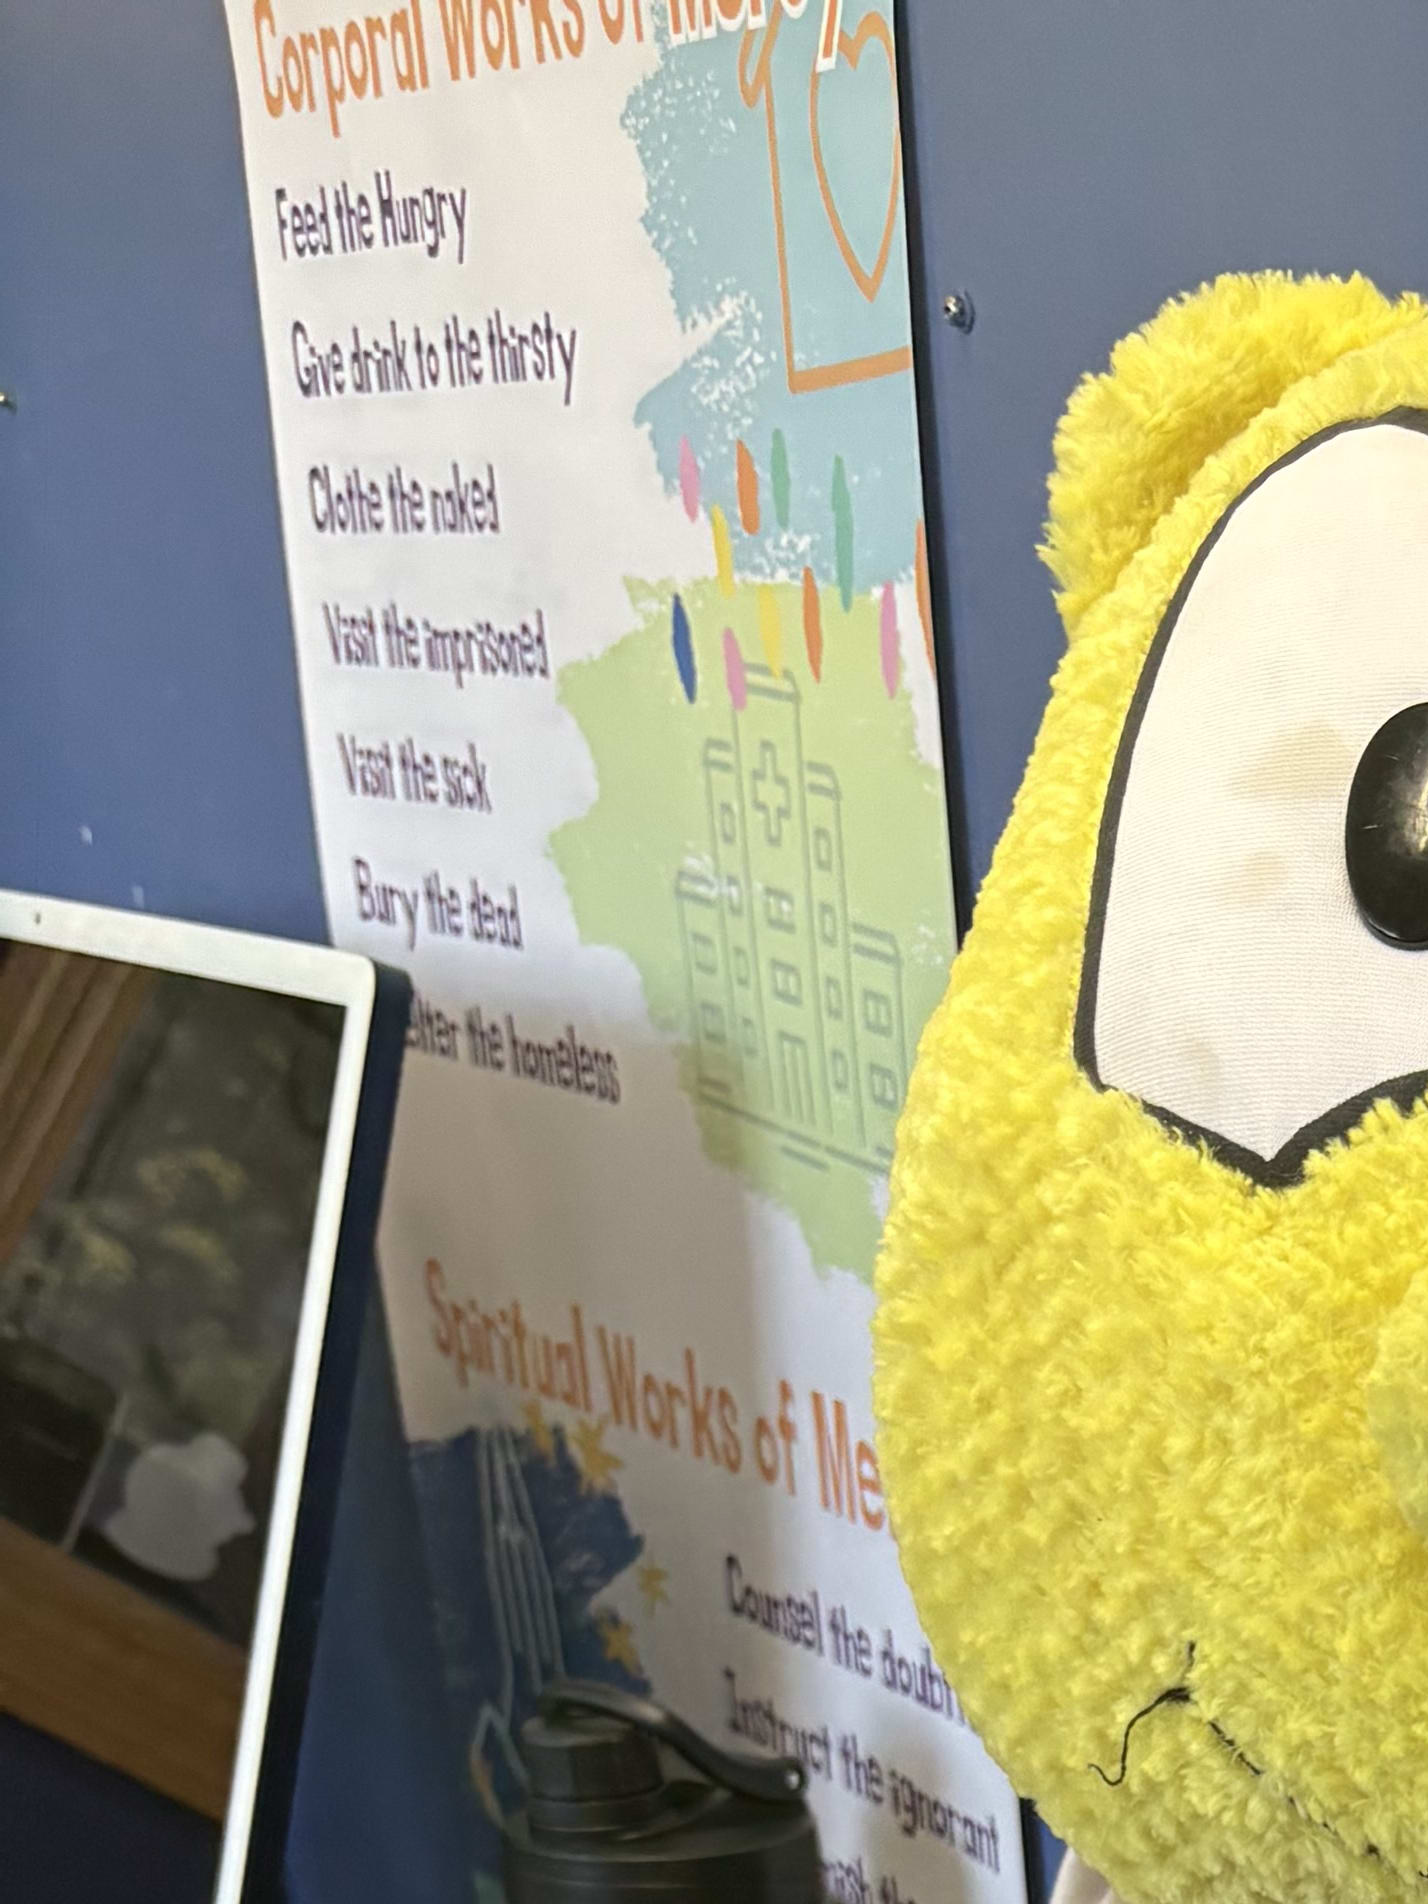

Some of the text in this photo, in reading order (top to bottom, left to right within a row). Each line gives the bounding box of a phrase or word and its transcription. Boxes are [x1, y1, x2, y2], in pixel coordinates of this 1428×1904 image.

[275, 169, 467, 264] Feed the Hungry
[291, 307, 577, 407] Give drink to the thirsty
[308, 461, 501, 534] Clothe the naked
[321, 600, 550, 688] Visit the imprisoned
[336, 732, 493, 815] Visit the sick
[353, 854, 525, 952] Bury the dead
[463, 1005, 505, 1072] the
[505, 1012, 622, 1105] homeless
[425, 1255, 593, 1413] Spiritual
[596, 1323, 743, 1476] Works
[754, 1377, 797, 1497] of
[725, 1554, 825, 1658] Counsel
[829, 1604, 873, 1678] the
[840, 1734, 885, 1805] the
[889, 1769, 1001, 1875] ignorant
